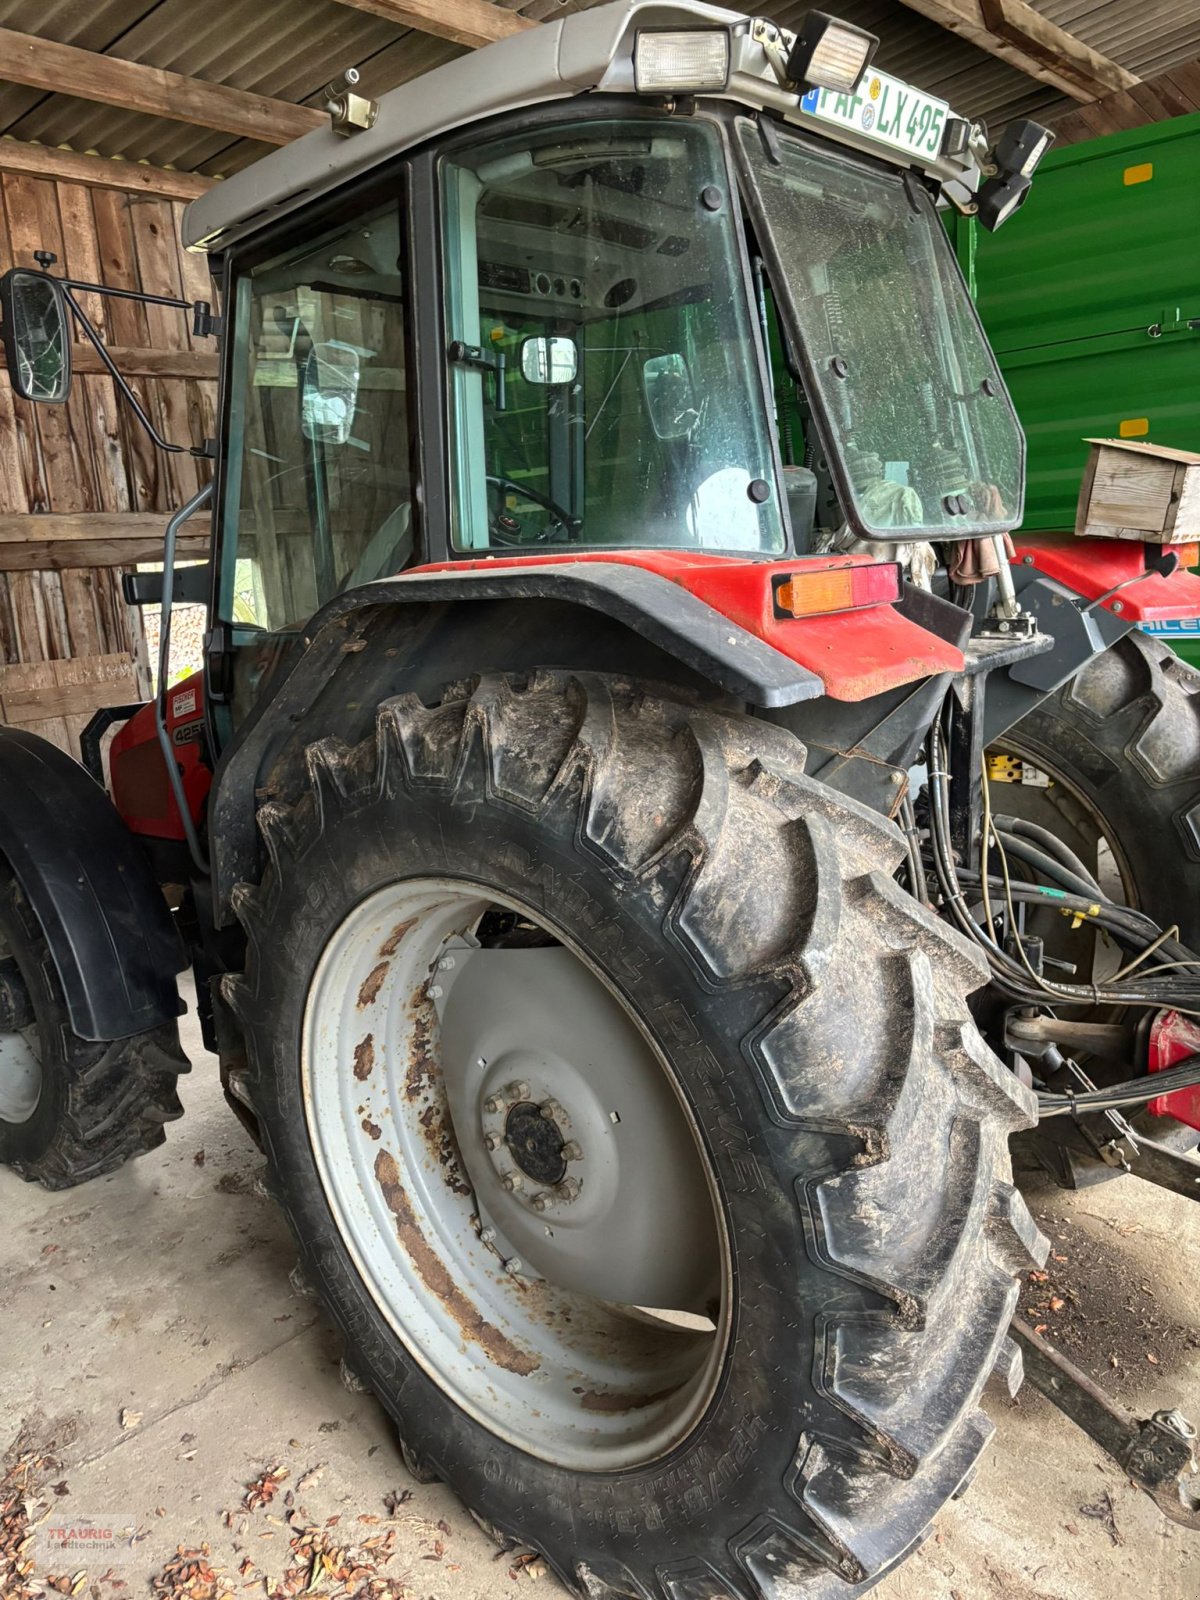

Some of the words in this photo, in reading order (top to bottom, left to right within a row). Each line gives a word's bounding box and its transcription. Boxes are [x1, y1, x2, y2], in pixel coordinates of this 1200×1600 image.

[876, 84, 908, 139] LX
[906, 99, 944, 152] 495
[1136, 619, 1200, 631] AILE
